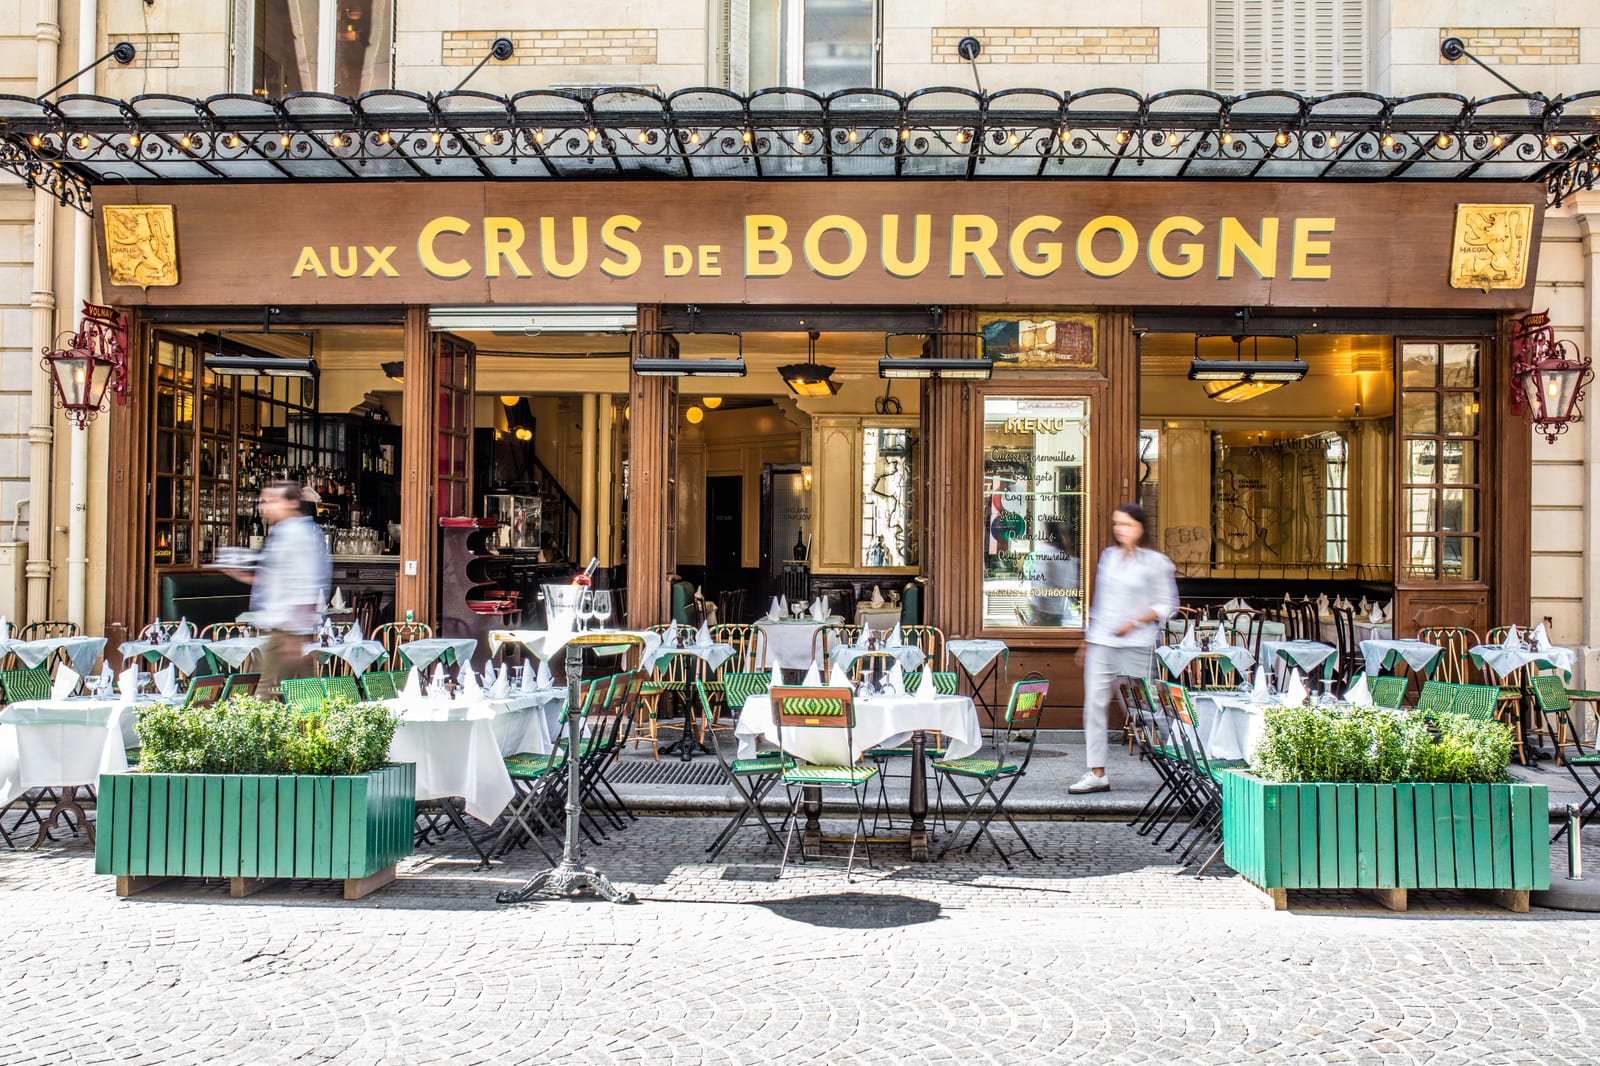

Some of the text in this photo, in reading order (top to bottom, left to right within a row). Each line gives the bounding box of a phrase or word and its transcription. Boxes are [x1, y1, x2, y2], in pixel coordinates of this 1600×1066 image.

[291, 213, 1336, 281] AUX CRUS DE BOURGOGNE
[89, 305, 113, 318] VOLNAY
[1004, 417, 1065, 433] MENU
[1031, 451, 1076, 467] grenouilles
[1004, 488, 1022, 506] Coq
[1029, 588, 1085, 598] BOURGOGNE
